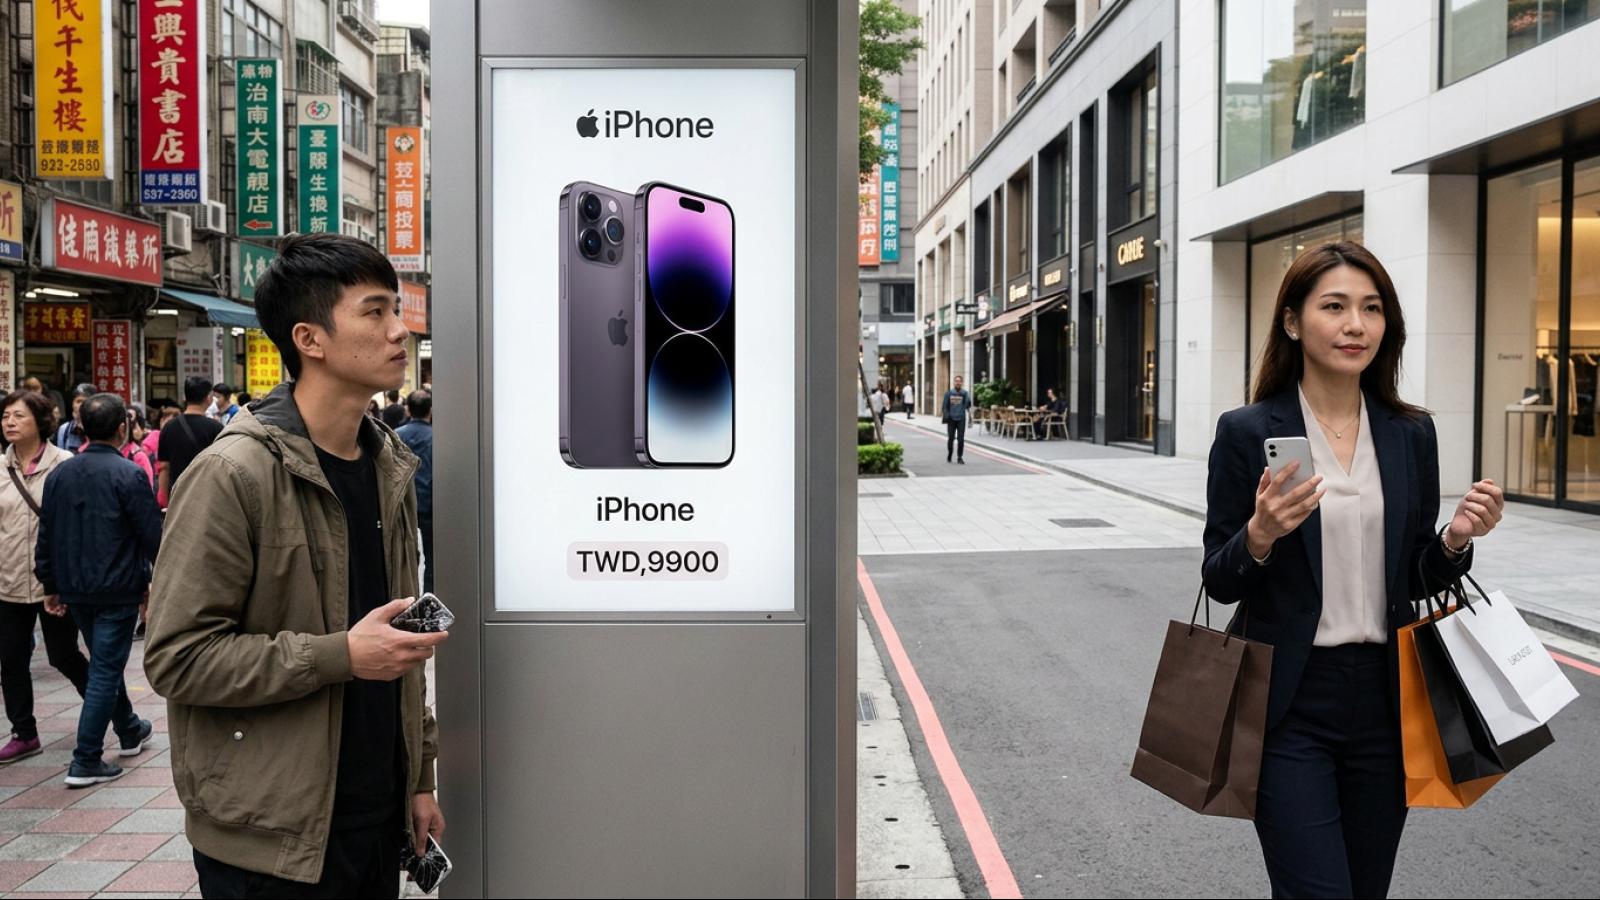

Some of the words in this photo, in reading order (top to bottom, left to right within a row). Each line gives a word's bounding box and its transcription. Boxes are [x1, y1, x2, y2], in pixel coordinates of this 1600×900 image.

[605, 110, 714, 138] iPhone
[597, 496, 694, 521] iPhone
[577, 550, 719, 577] TWD,9900
